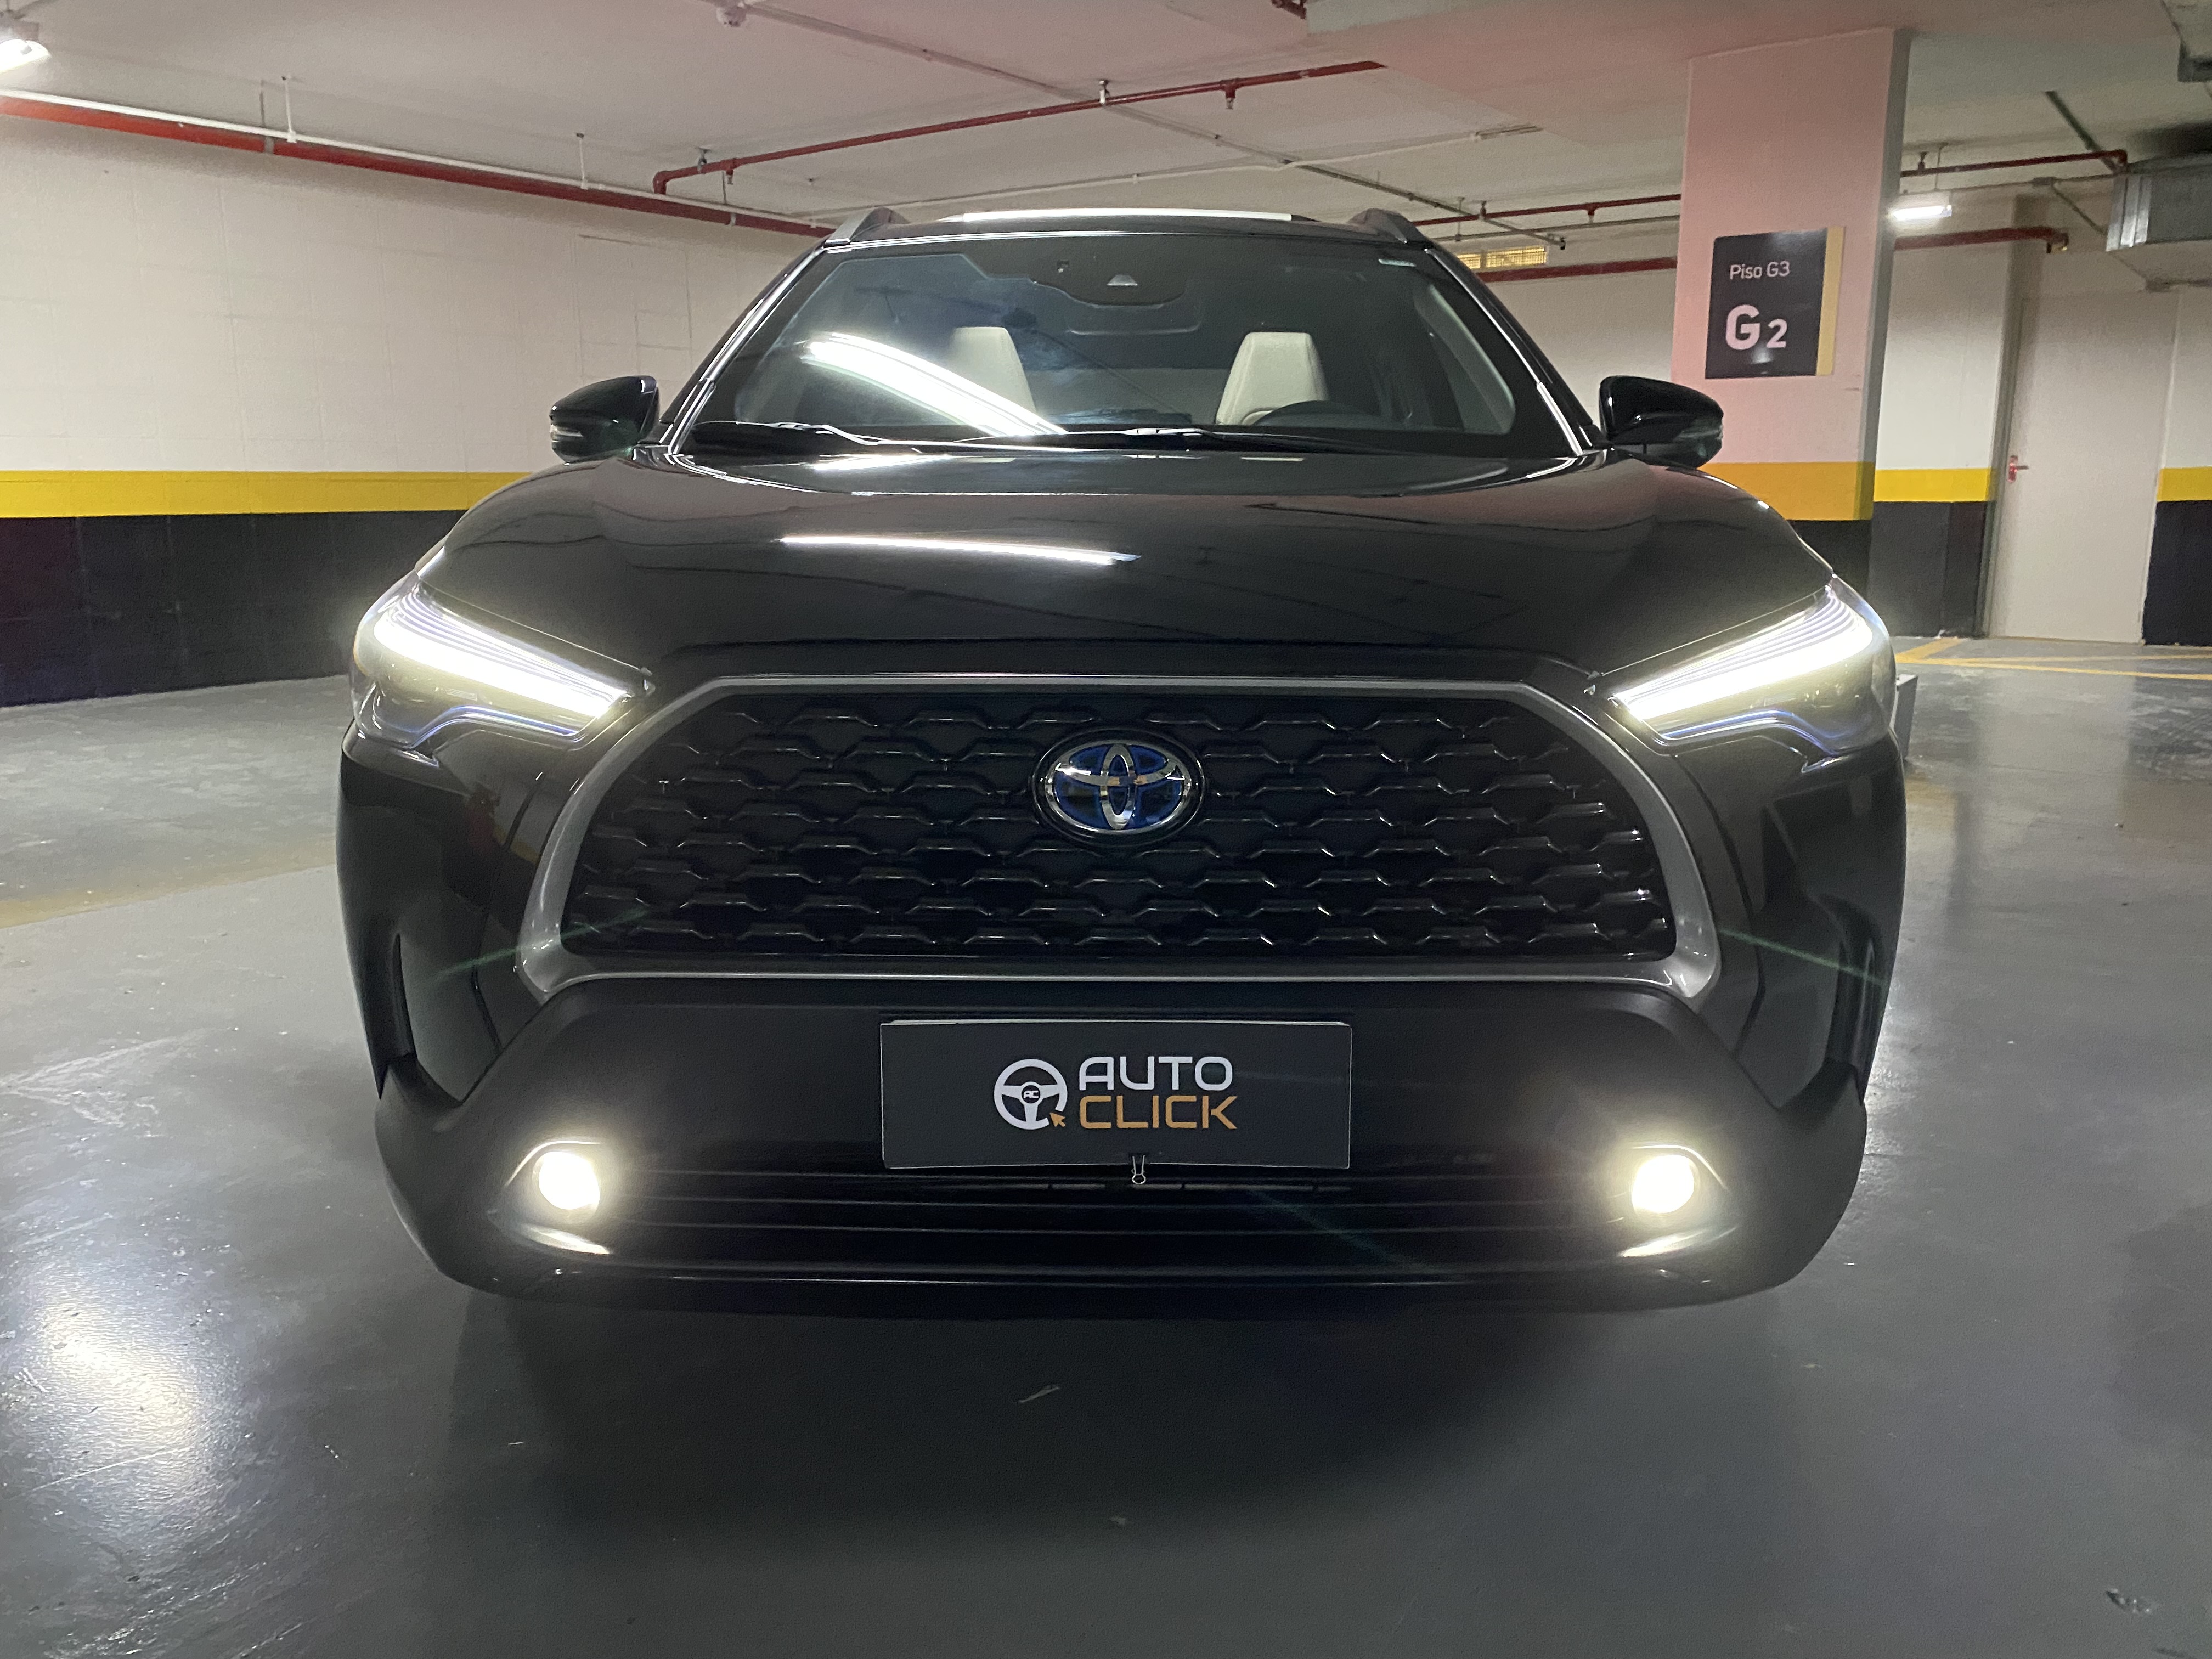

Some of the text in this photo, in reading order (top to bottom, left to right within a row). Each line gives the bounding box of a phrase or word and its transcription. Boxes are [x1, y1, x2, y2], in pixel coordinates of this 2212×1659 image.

[1730, 261, 1790, 280] Piso G3
[1079, 1056, 1233, 1091] AUTO
[1023, 1090, 1039, 1099] AC
[1080, 1096, 1238, 1129] CLICK
